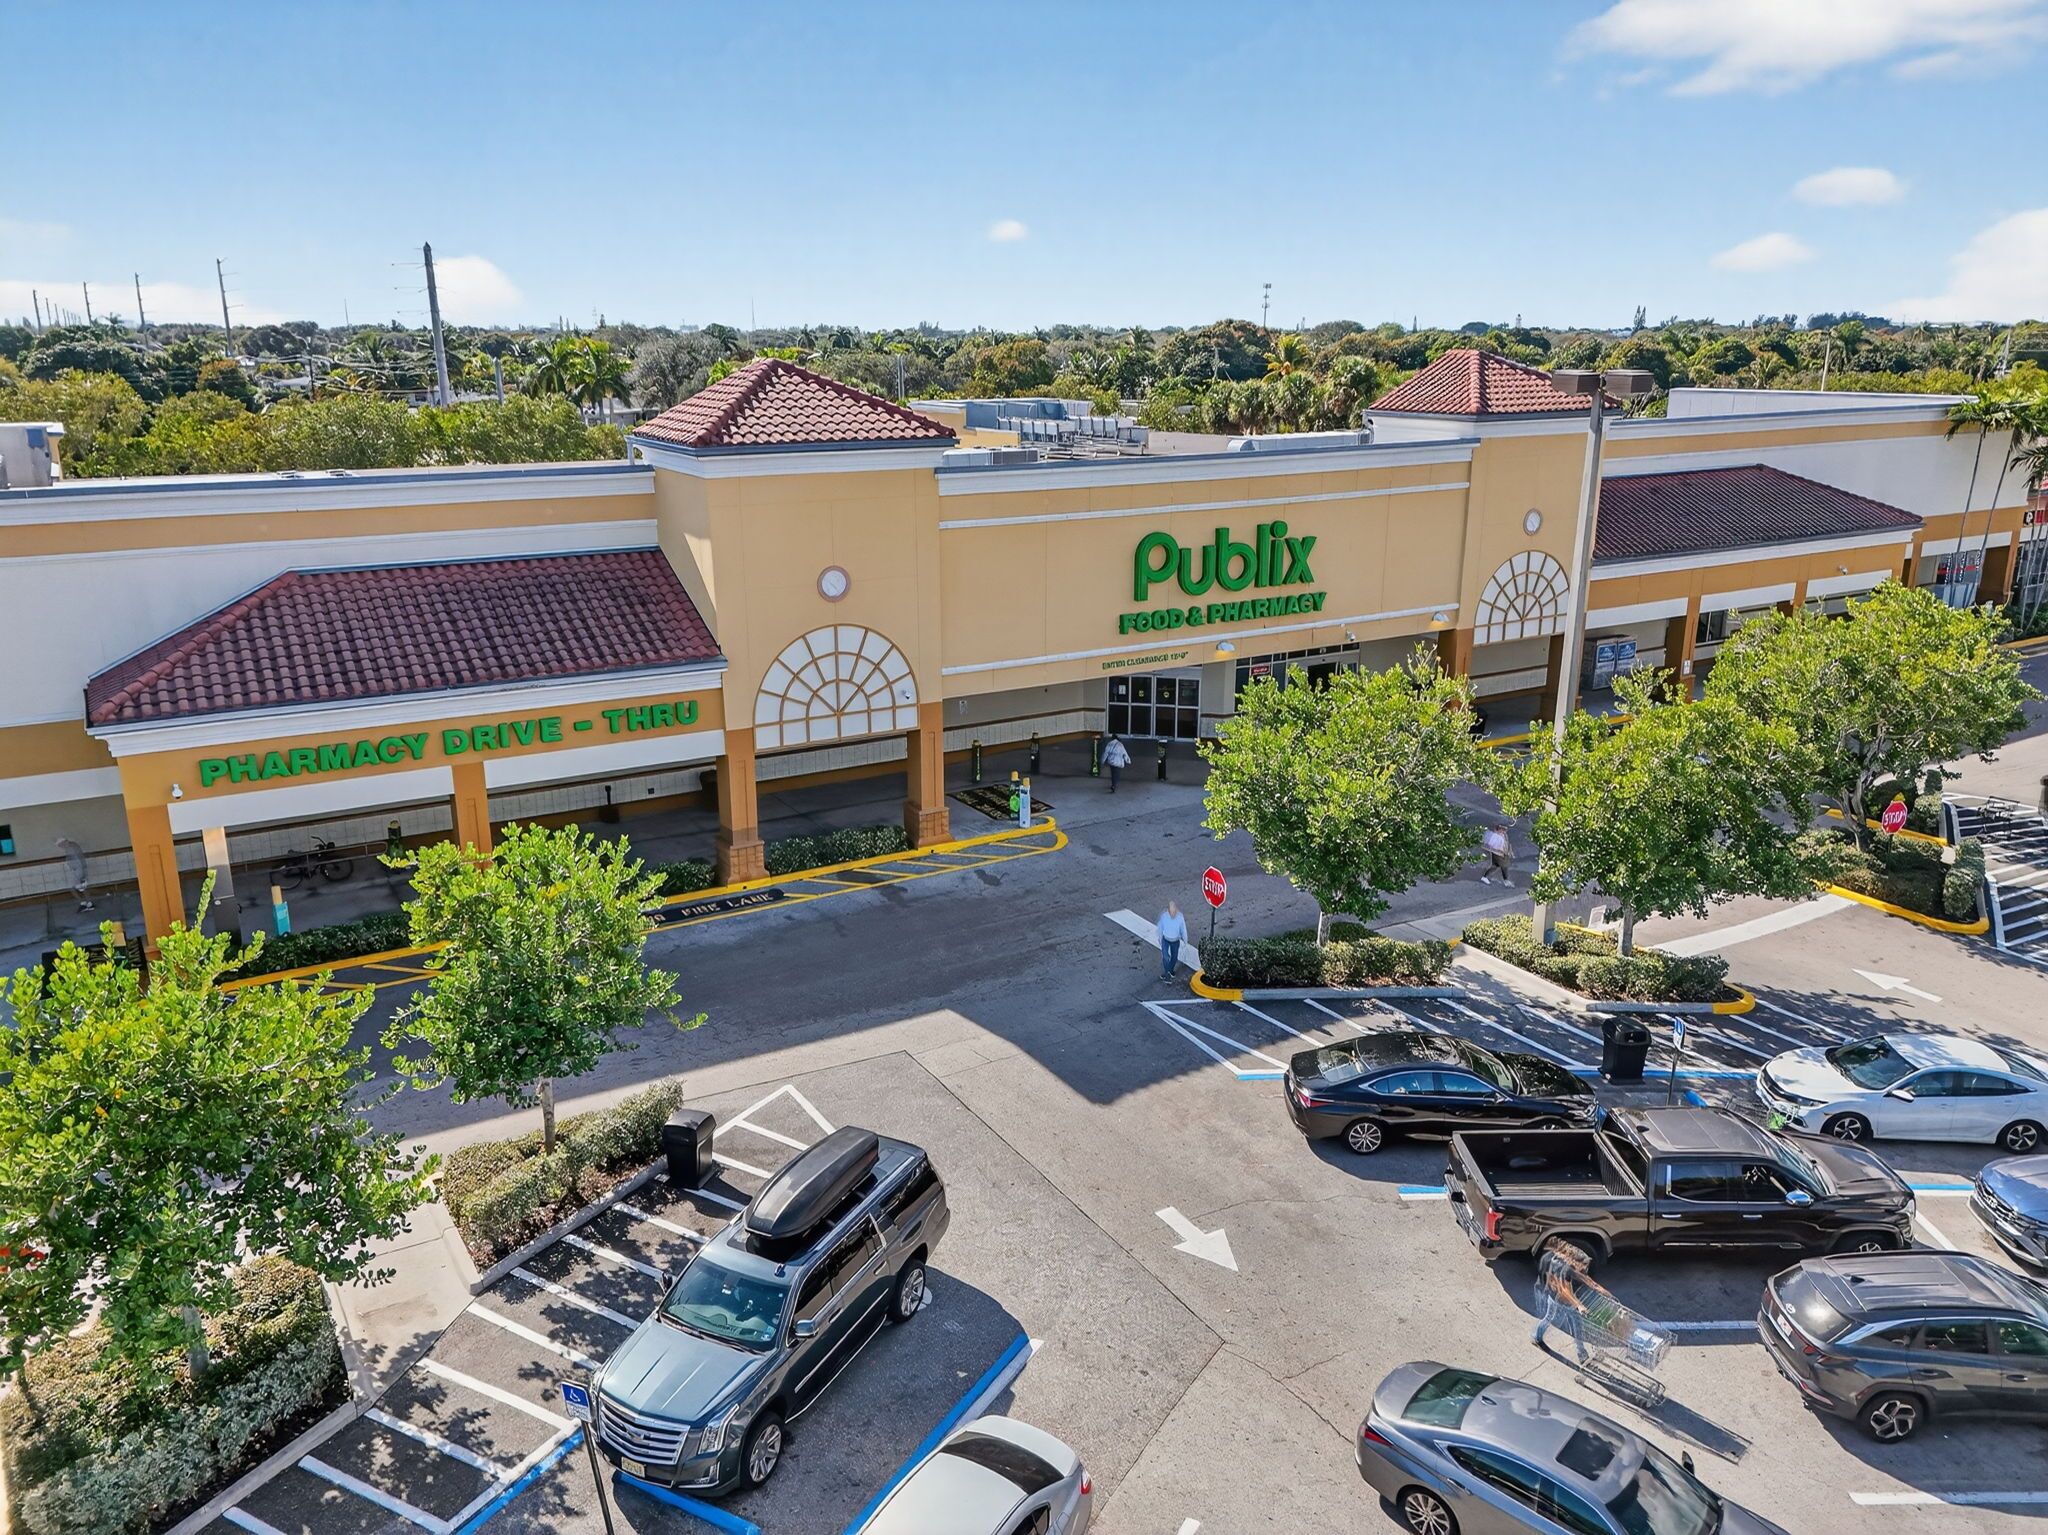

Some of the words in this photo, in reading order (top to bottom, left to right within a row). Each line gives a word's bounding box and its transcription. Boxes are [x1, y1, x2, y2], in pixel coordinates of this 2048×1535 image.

[1134, 520, 1317, 601] Publix
[1119, 608, 1185, 635] FOOD
[1186, 606, 1206, 627] &
[1207, 591, 1327, 624] PHARMACY
[199, 733, 429, 787] PHARMACY
[442, 716, 563, 755] DRIVE
[602, 700, 699, 734] THRU
